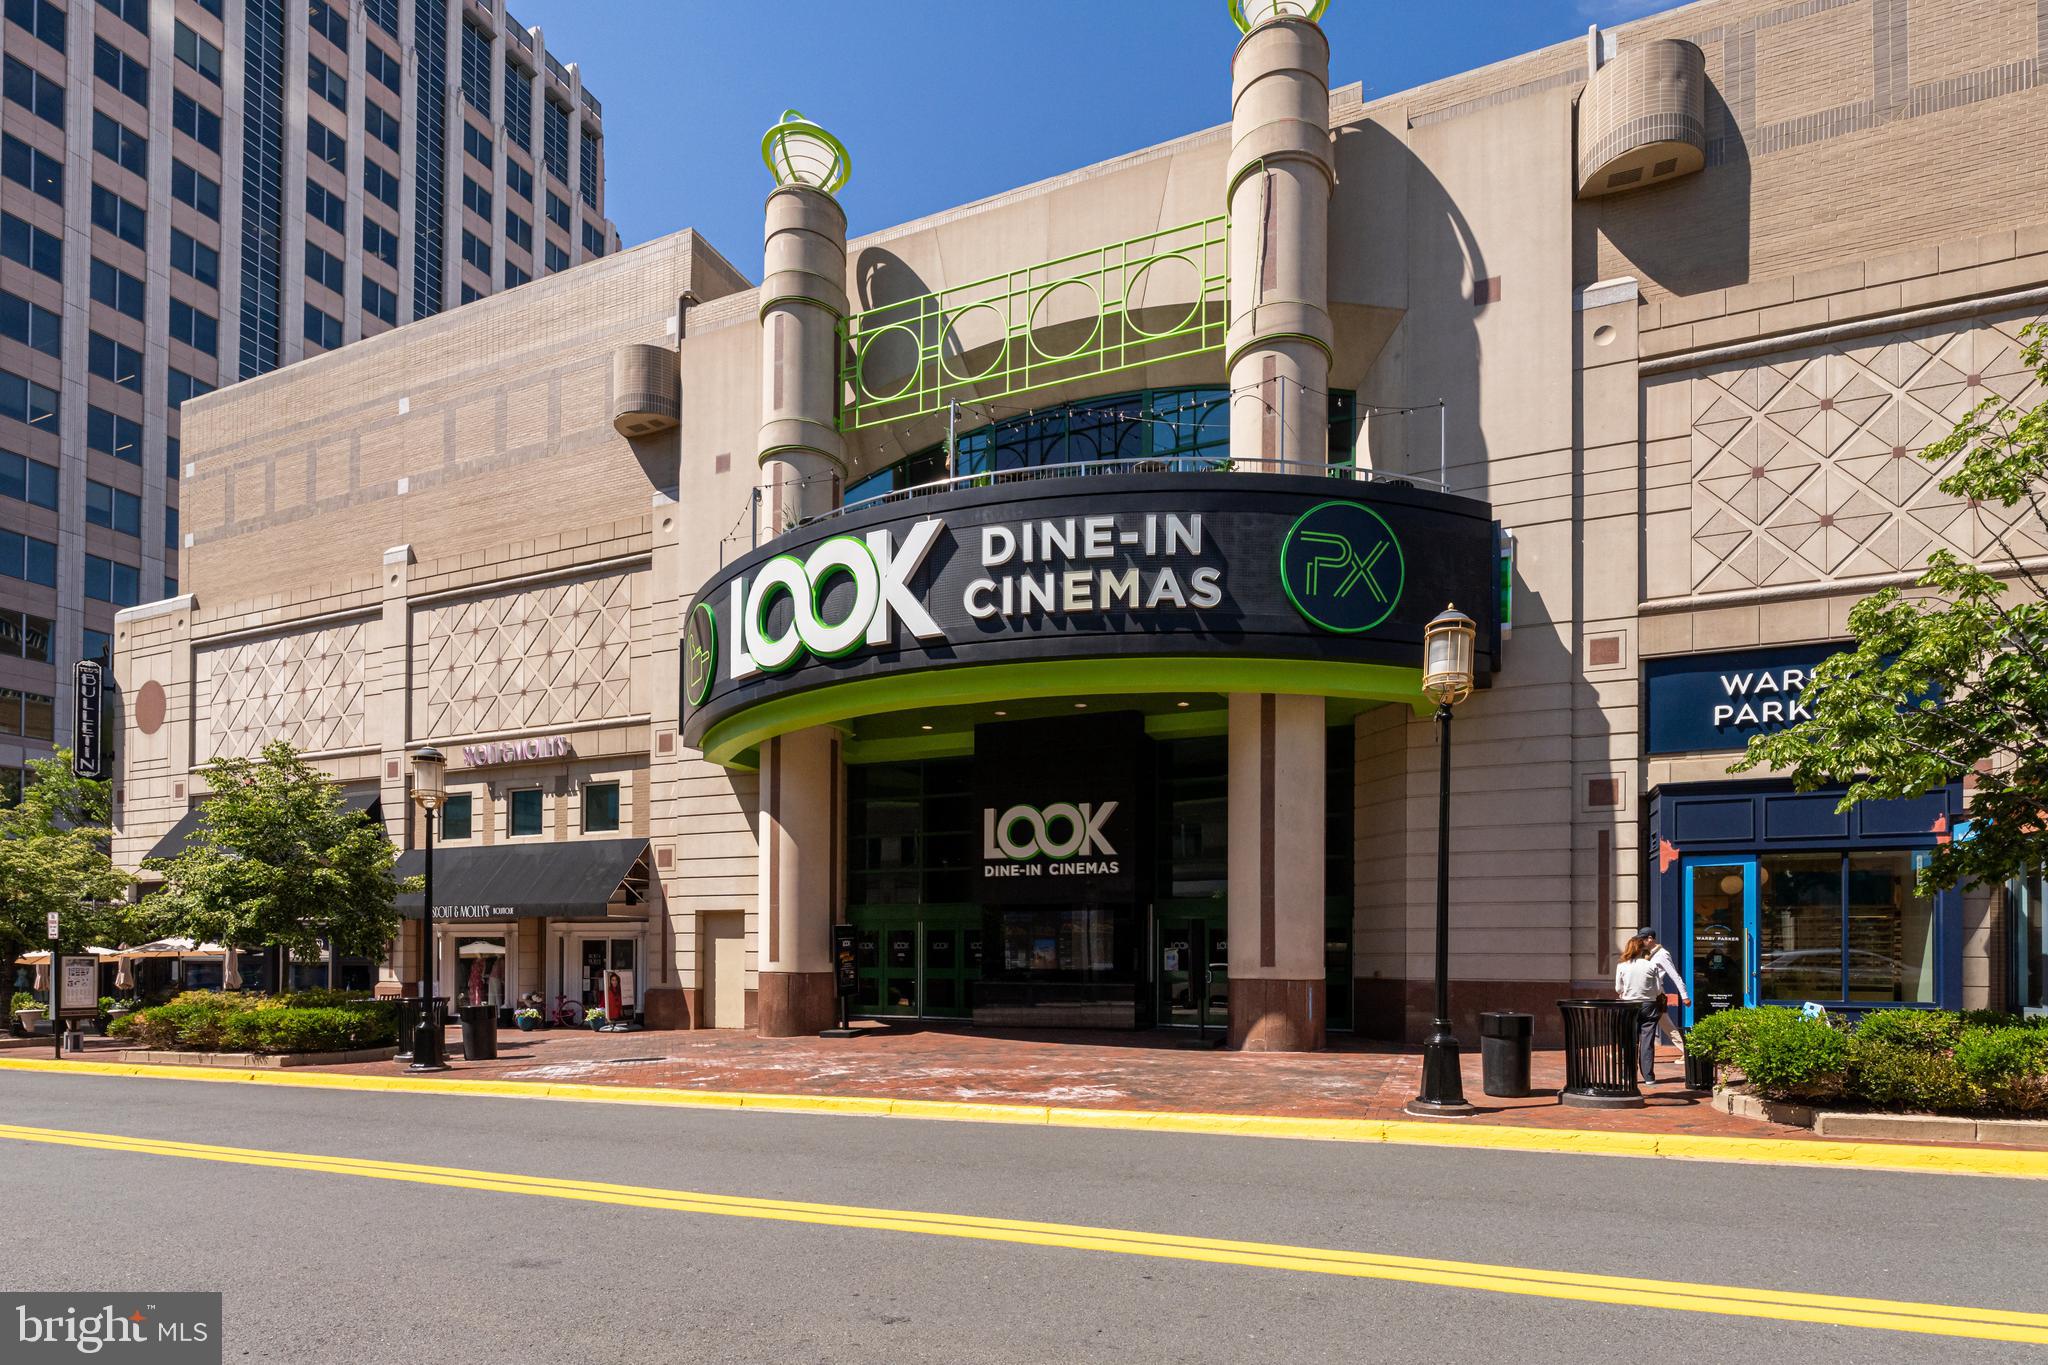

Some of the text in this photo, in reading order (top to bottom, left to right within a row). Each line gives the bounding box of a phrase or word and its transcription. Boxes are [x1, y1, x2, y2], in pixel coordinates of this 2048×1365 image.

[980, 513, 1203, 568] DINE-IN
[1300, 530, 1391, 604] PX
[730, 517, 947, 682] LOOK
[962, 567, 1222, 621] CINEMAS
[1720, 669, 1817, 696] WAR
[80, 673, 97, 771] BULLETIN
[1713, 700, 1812, 726] PARK
[984, 801, 1120, 861] LOOK
[984, 861, 1120, 877] DINE-IN CINEMAS
[432, 905, 453, 918] SCOUT
[454, 905, 459, 918] &
[460, 904, 491, 918] MOLLY'S
